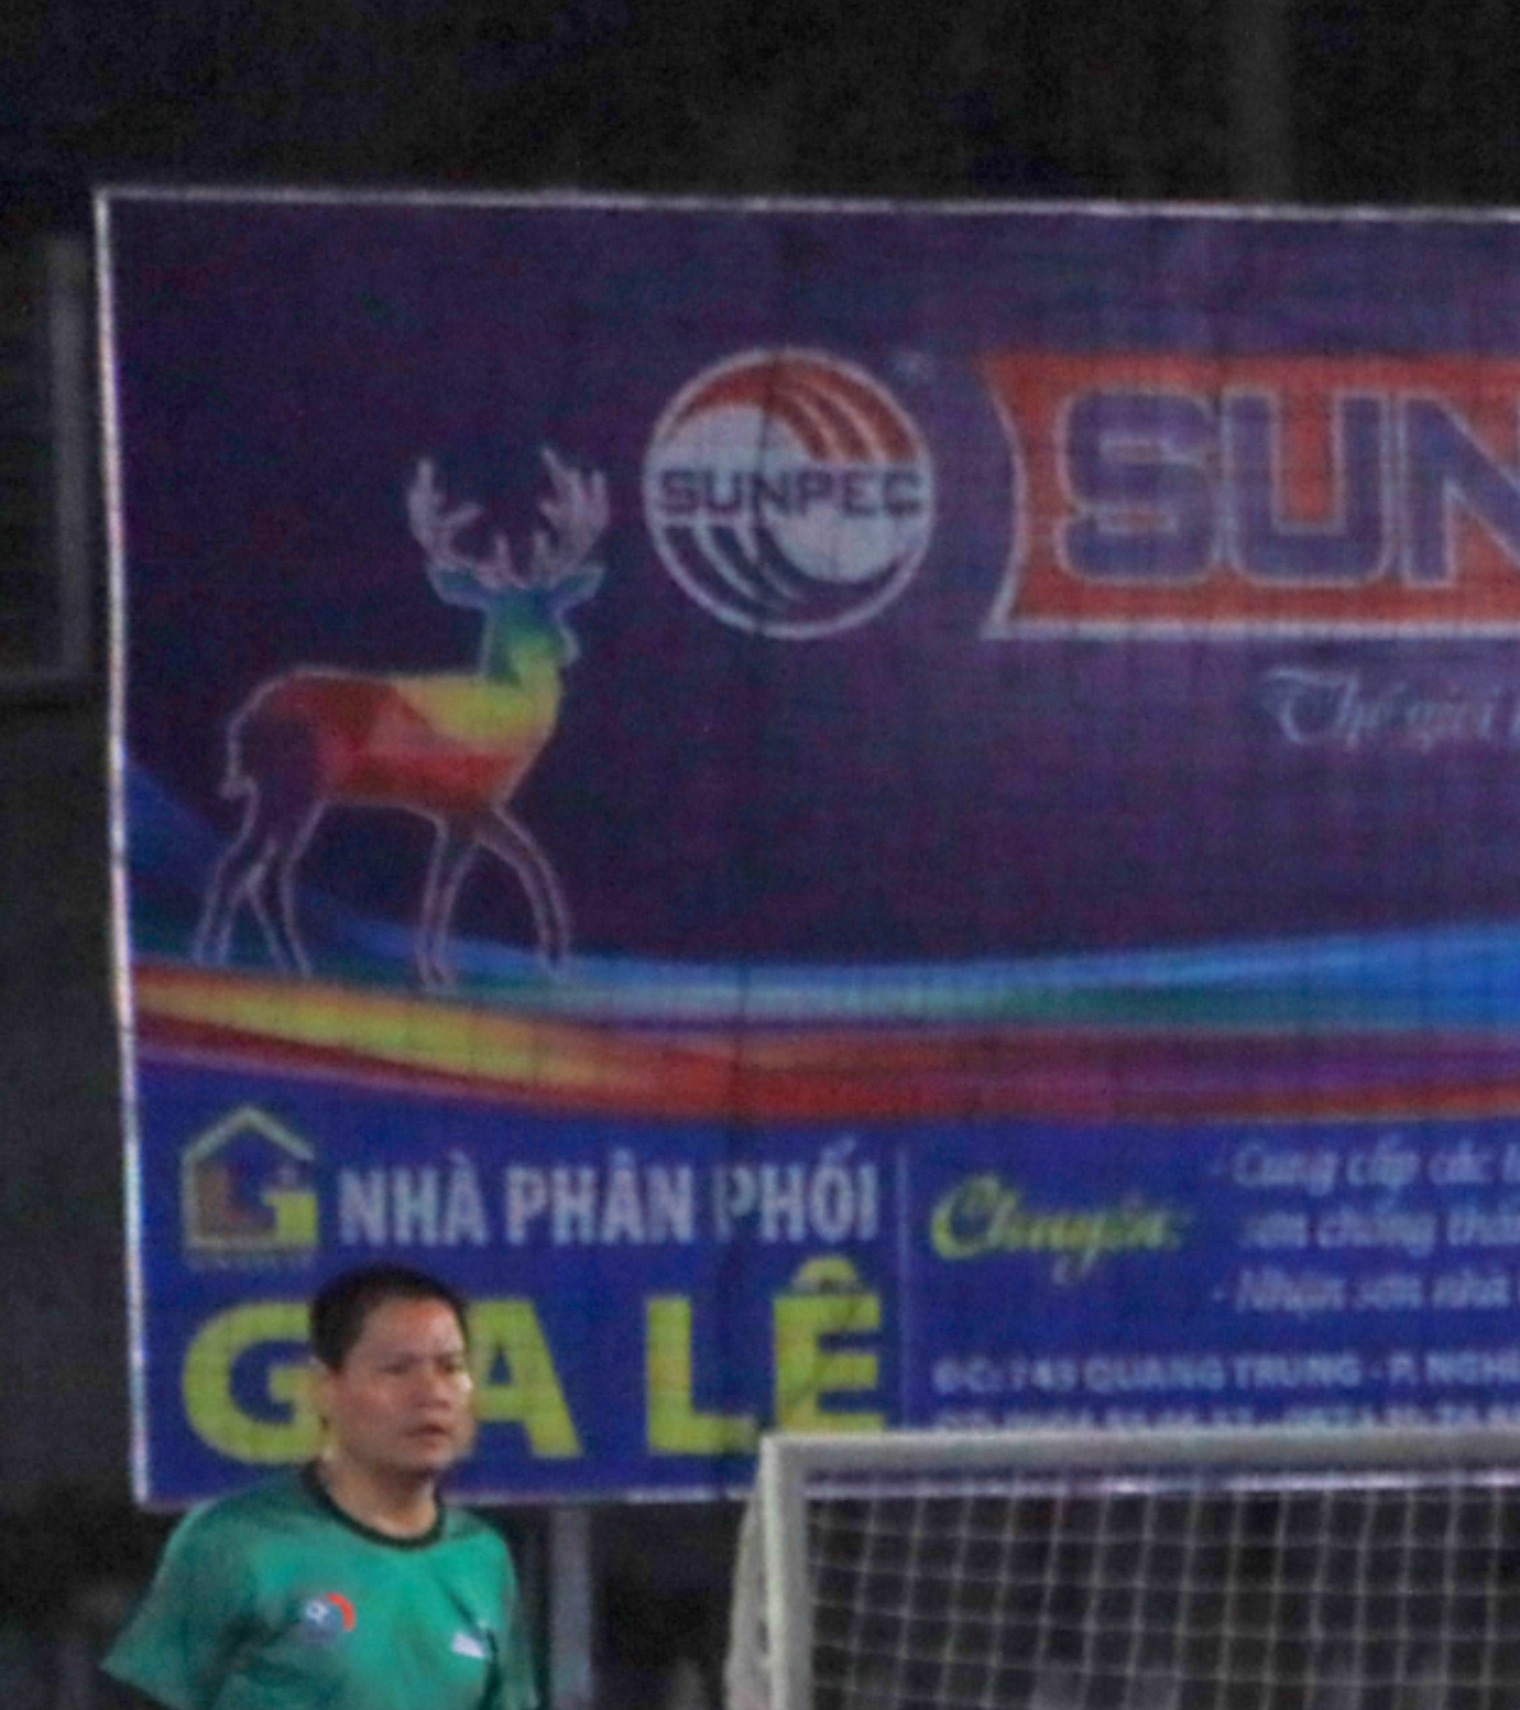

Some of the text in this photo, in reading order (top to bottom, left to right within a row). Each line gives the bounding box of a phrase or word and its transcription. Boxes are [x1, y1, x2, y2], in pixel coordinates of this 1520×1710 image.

[661, 466, 923, 521] SUNPEC
[338, 1136, 880, 1247] NHÀ PHÂN PHỐI
[181, 1255, 887, 1465] GA LÊ
